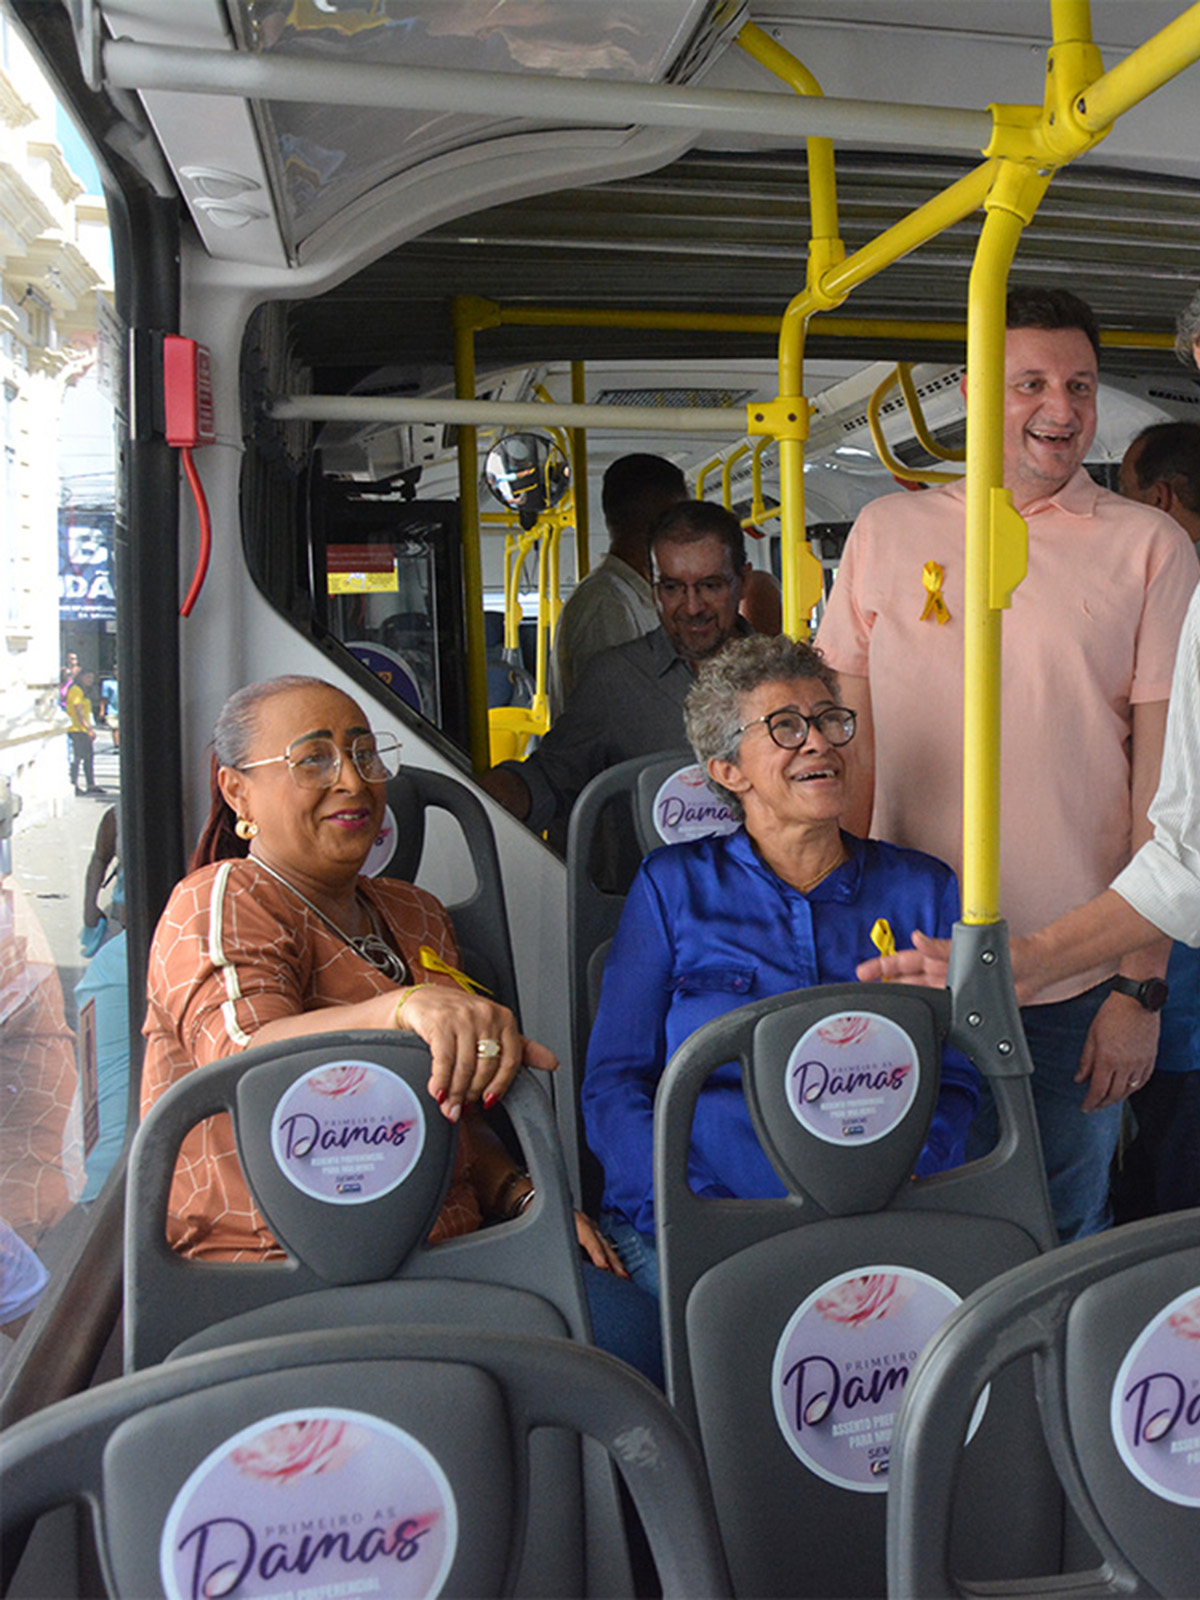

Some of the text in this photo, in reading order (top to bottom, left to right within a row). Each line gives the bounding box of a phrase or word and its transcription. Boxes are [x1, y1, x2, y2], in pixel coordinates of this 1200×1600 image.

[658, 796, 736, 828] Dama
[792, 1060, 908, 1105] Damas
[279, 1113, 411, 1159] Damas
[845, 1350, 918, 1372] PRIMEIRO
[783, 1355, 909, 1431] Dam
[264, 1506, 398, 1537] PRIMEIRO AS
[178, 1517, 431, 1600] Damas
